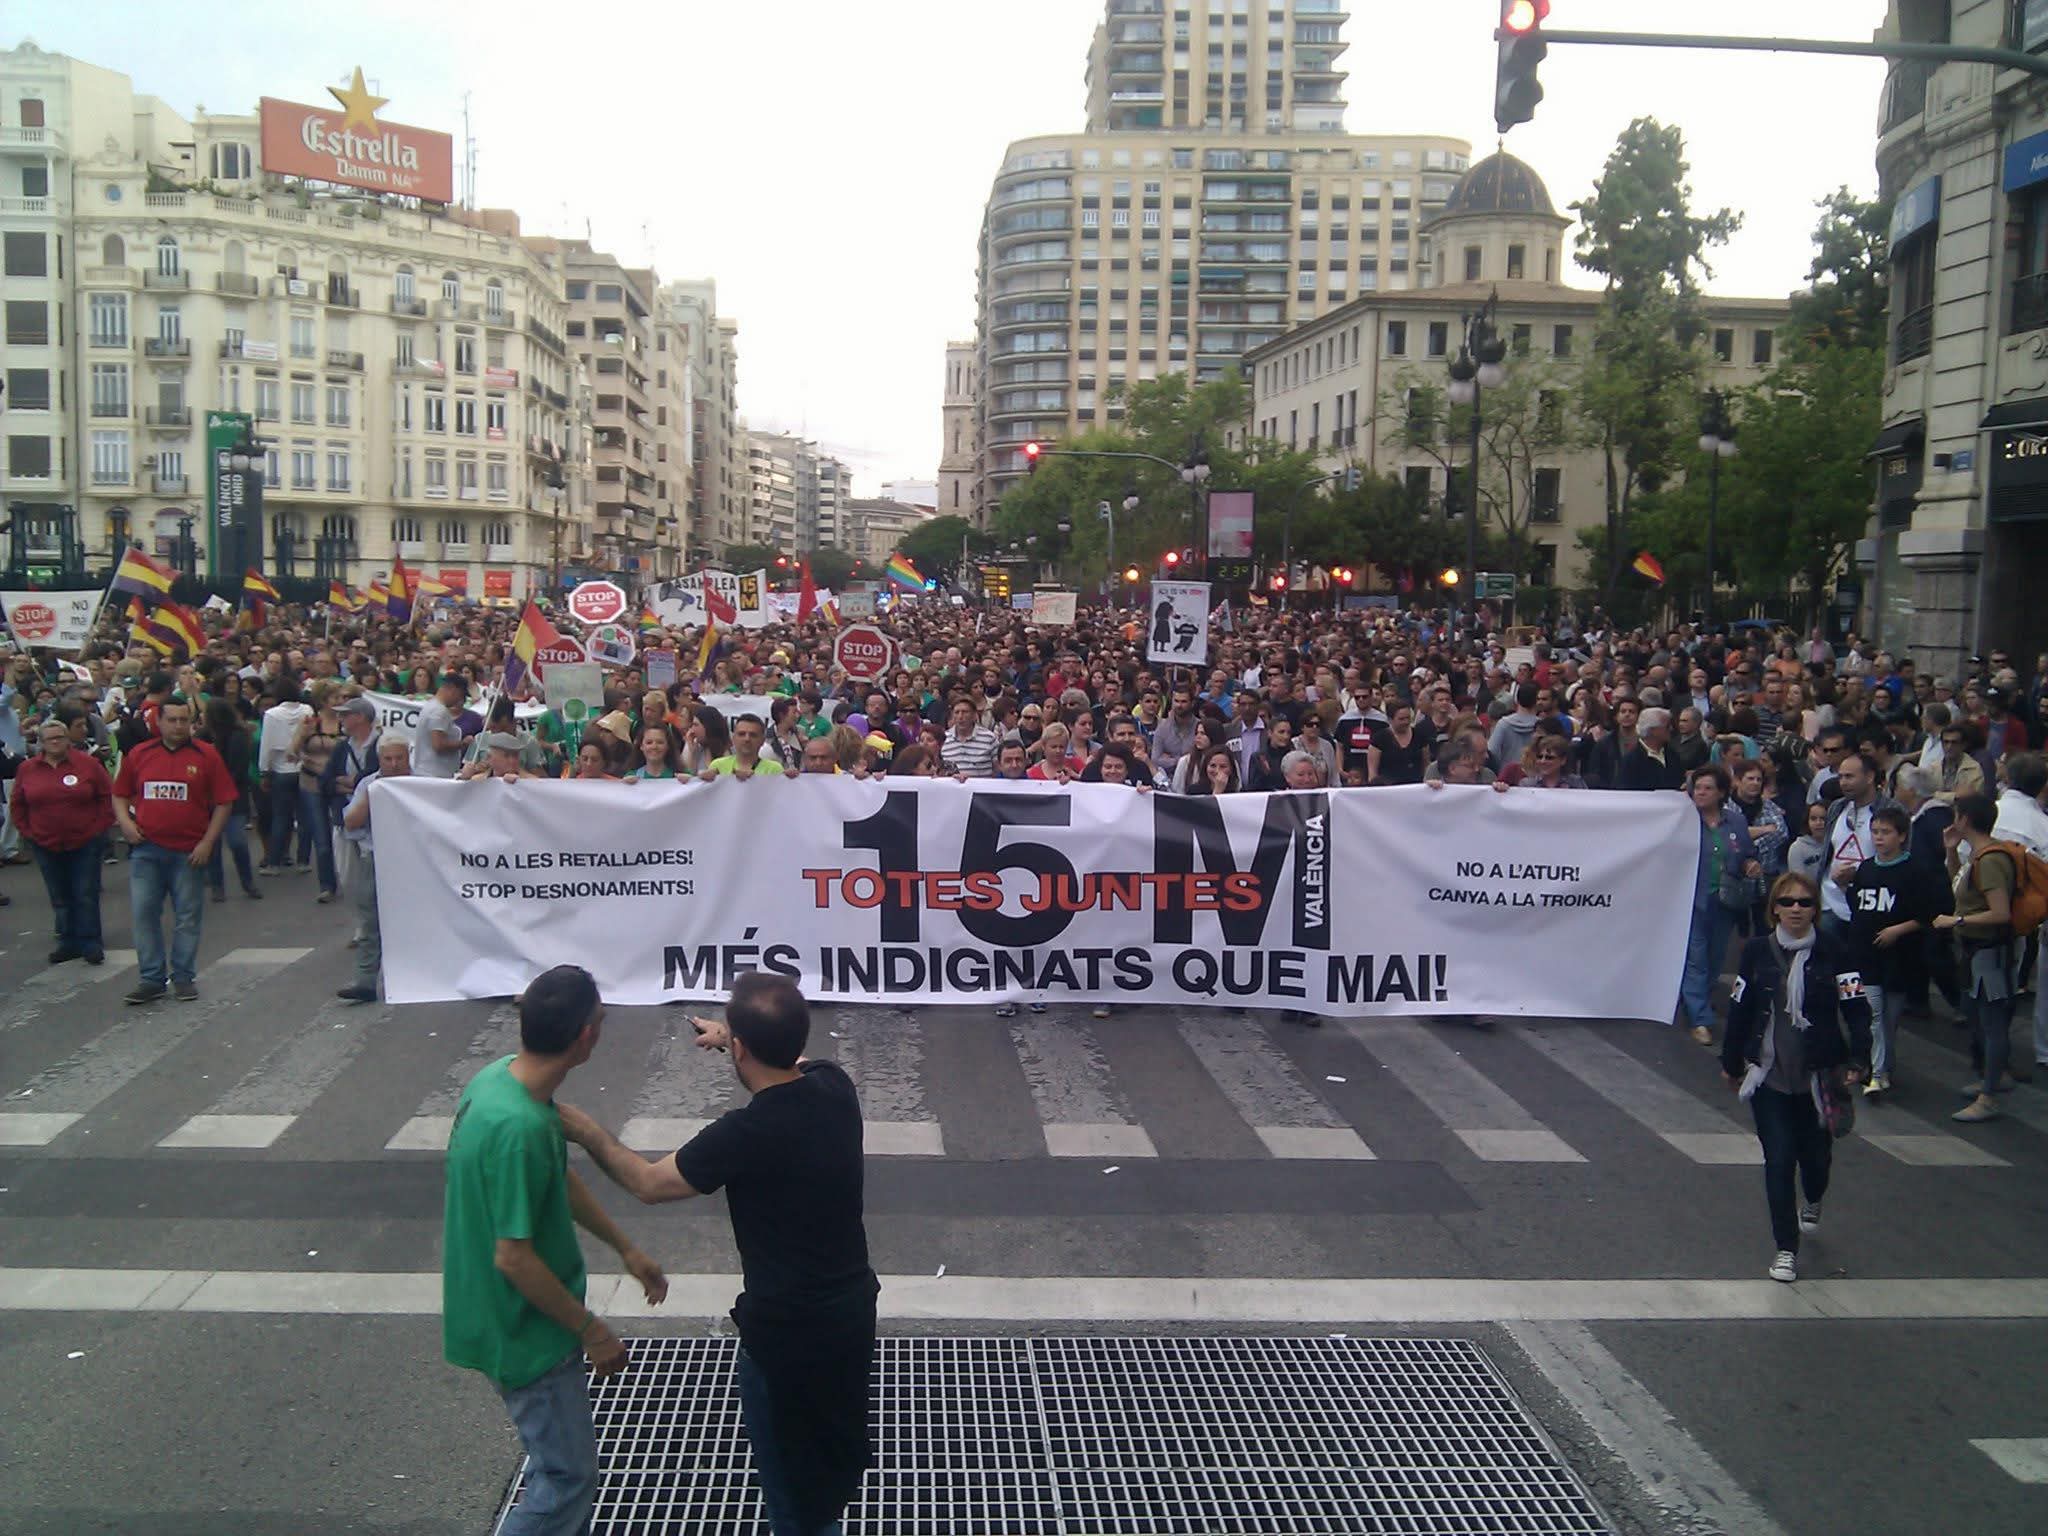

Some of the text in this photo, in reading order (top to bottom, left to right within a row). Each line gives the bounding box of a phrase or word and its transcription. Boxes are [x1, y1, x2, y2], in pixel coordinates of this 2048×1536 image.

[302, 115, 419, 170] Estrella
[336, 158, 387, 183] Damm
[232, 474, 243, 504] NORD
[741, 578, 756, 592] 15
[577, 592, 615, 602] STOP
[741, 594, 757, 610] M
[15, 609, 49, 621] STOP
[537, 650, 578, 661] STOP
[844, 642, 883, 656] STOP
[460, 850, 694, 869] NO A LES RETALLADES!
[843, 789, 1331, 950] 15M
[1305, 814, 1324, 928] VALÈNCIA
[1456, 862, 1580, 881] NO A L'ATUR!
[461, 880, 694, 899] STOP DESNONAMENTS!
[802, 868, 1262, 911] TOTES JUNTES
[1428, 887, 1612, 907] CANYA A LA TROIKA!
[1857, 888, 1896, 911] 15M
[664, 927, 1448, 1003] MÉS INDIGNATS QUE MAI!
